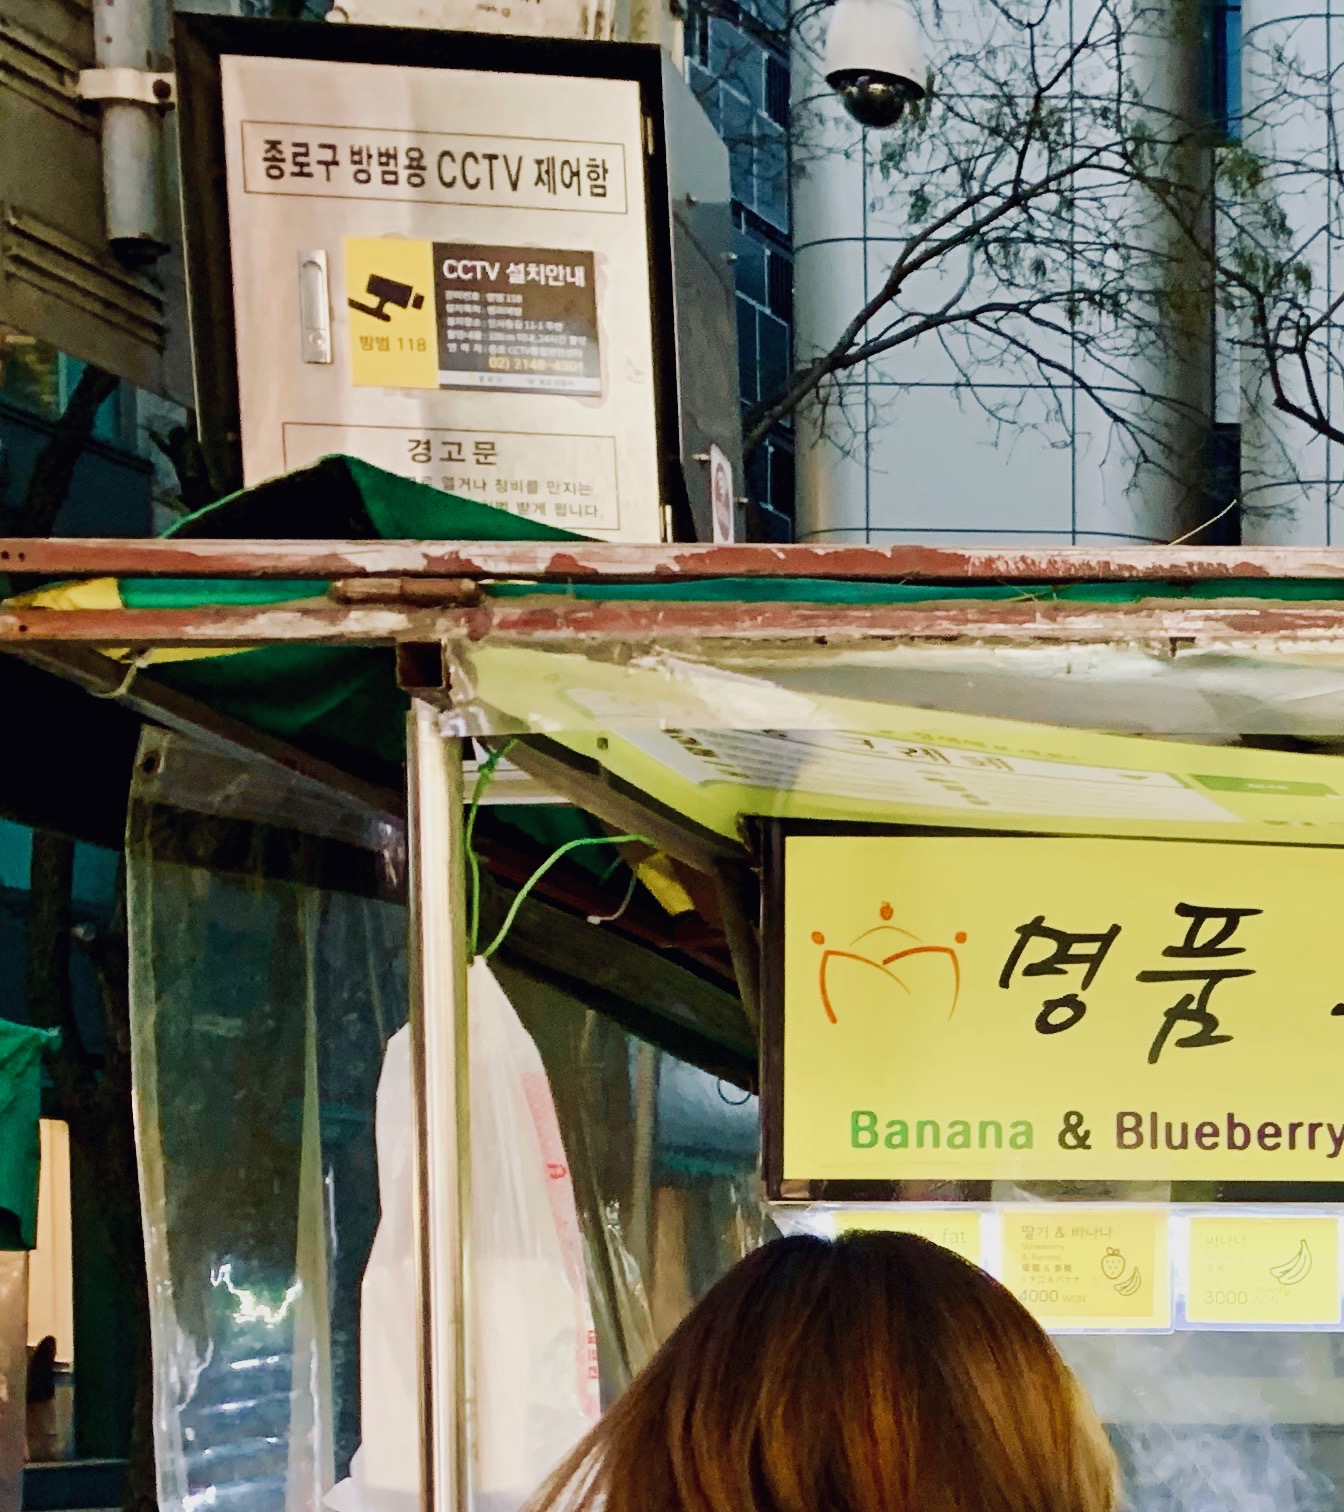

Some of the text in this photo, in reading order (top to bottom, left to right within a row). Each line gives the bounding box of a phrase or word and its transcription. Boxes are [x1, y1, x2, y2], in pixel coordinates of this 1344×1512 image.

[262, 139, 609, 198] 종로구 방범용 CCTV 제어함
[442, 258, 586, 288] CCTV 설치안내
[359, 335, 391, 352] 방범
[396, 337, 427, 352] 118
[407, 438, 499, 467] 경고문
[441, 476, 488, 493] 열거나
[495, 478, 539, 495] 장비를
[546, 480, 593, 497] 만지는
[999, 901, 1264, 1064] 명품
[850, 1109, 1034, 1152] Banana
[1056, 1109, 1093, 1152] &
[1021, 1224, 1114, 1241] 딸기 & 바나나
[1206, 1233, 1248, 1248] 바나나
[1017, 1289, 1087, 1303] 4000 WON
[1204, 1290, 1249, 1305] 3000
